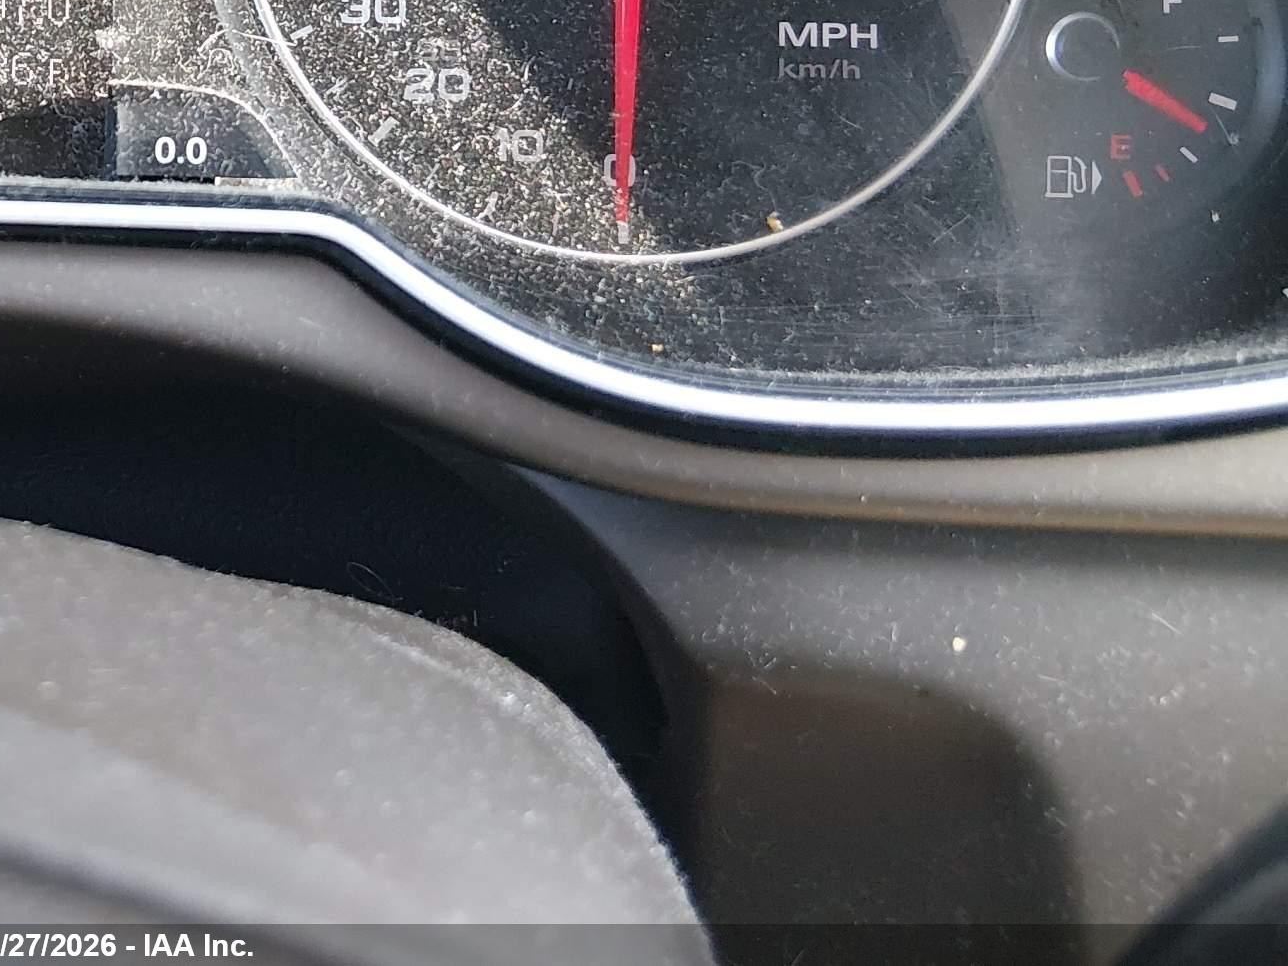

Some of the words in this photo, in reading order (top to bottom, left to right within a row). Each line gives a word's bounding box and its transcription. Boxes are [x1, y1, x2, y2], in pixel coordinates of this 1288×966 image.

[778, 20, 878, 49] MPH
[778, 57, 862, 80] km/h
[403, 67, 472, 103] 20
[154, 136, 208, 166] 0.0
[496, 127, 546, 163] 10
[1110, 134, 1132, 160] E
[603, 153, 636, 187] 0
